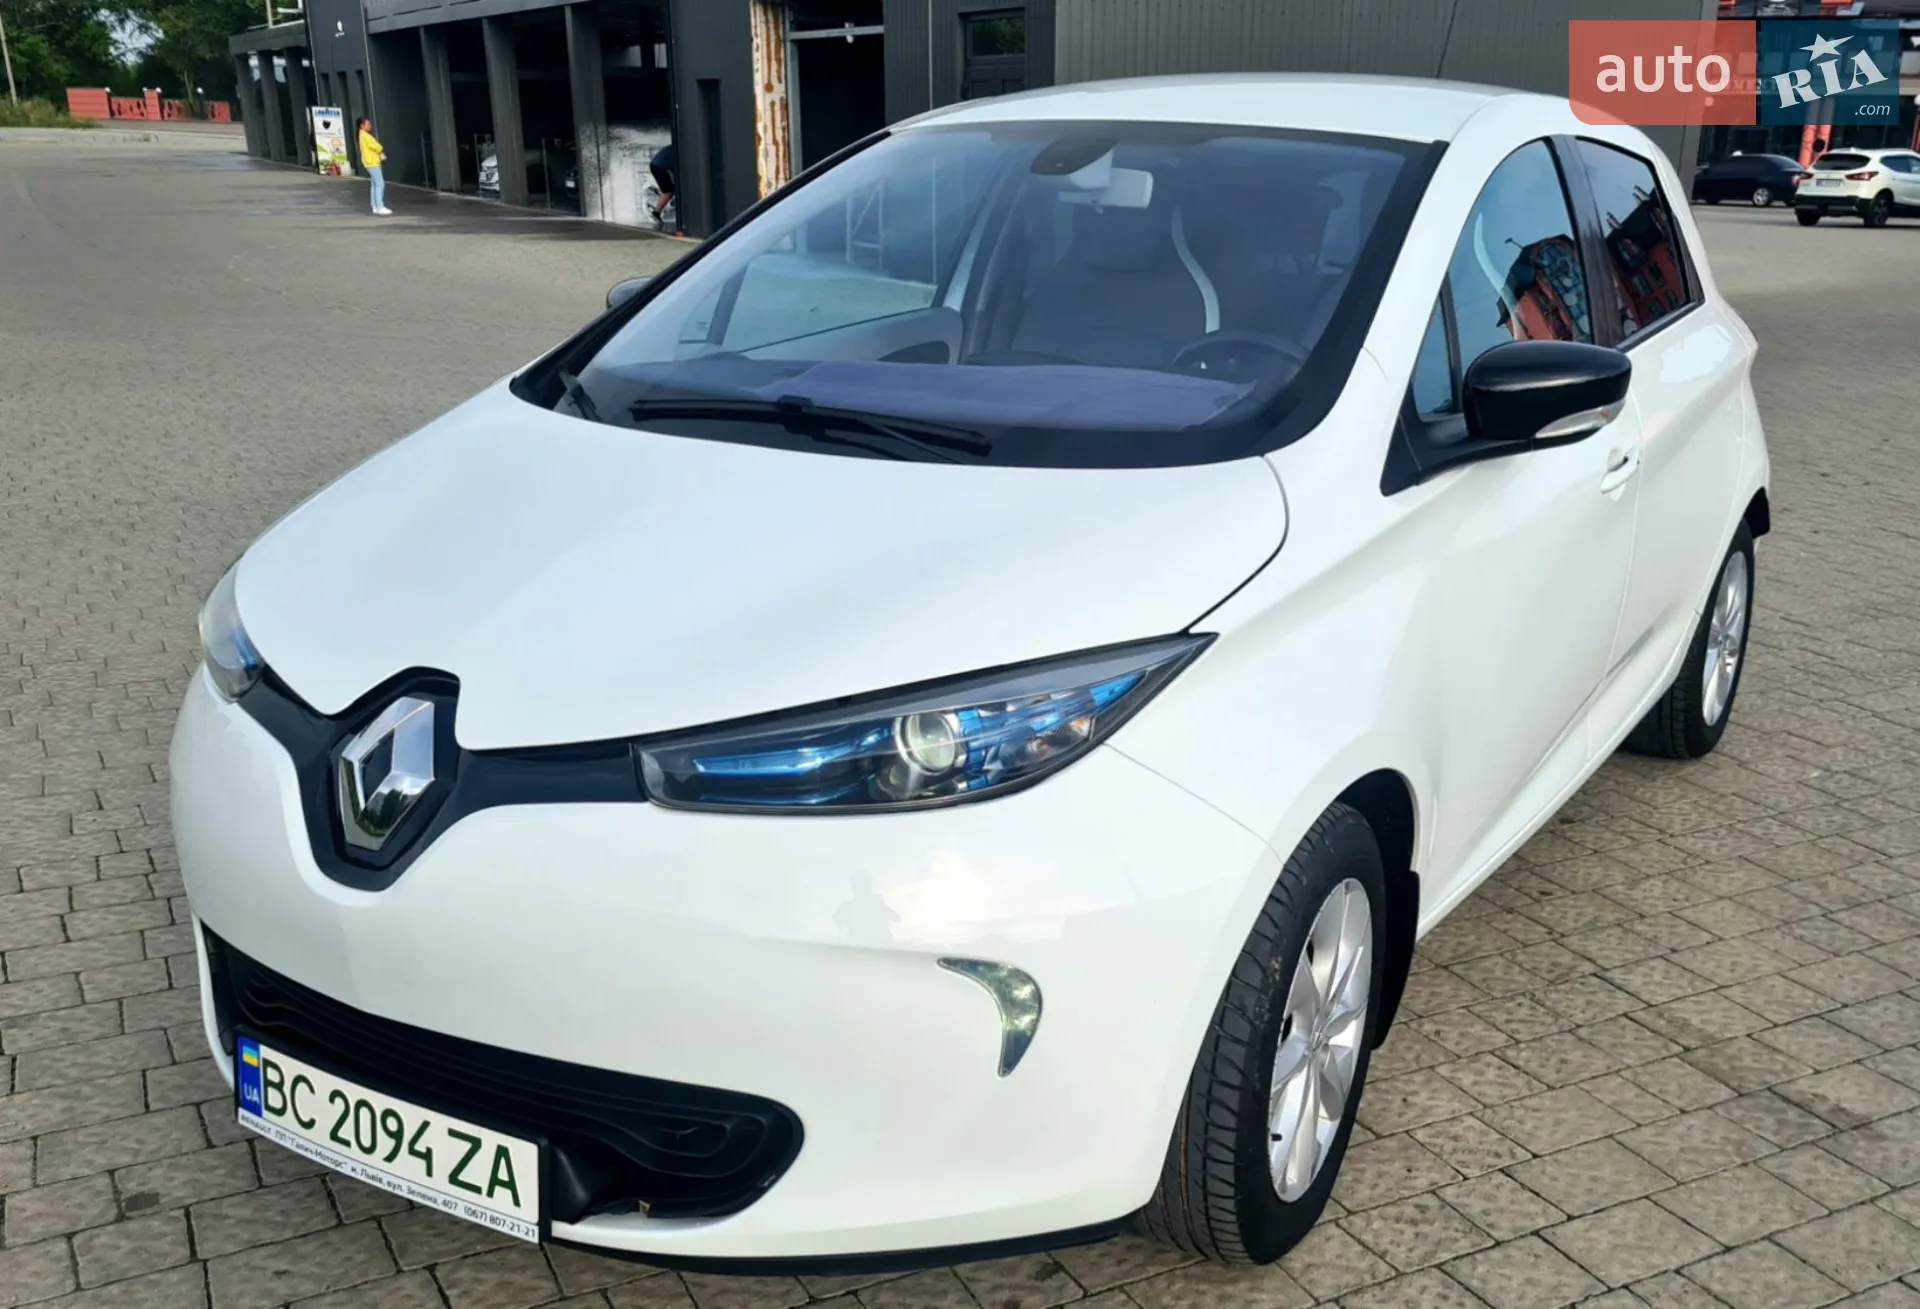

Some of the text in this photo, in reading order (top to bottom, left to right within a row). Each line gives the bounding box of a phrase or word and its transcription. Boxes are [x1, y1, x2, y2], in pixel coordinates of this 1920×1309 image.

[244, 1084, 260, 1104] UA
[261, 1057, 521, 1208] BC 2094 ZA
[441, 1198, 458, 1211] 407
[489, 1213, 536, 1238] 807-21-21
